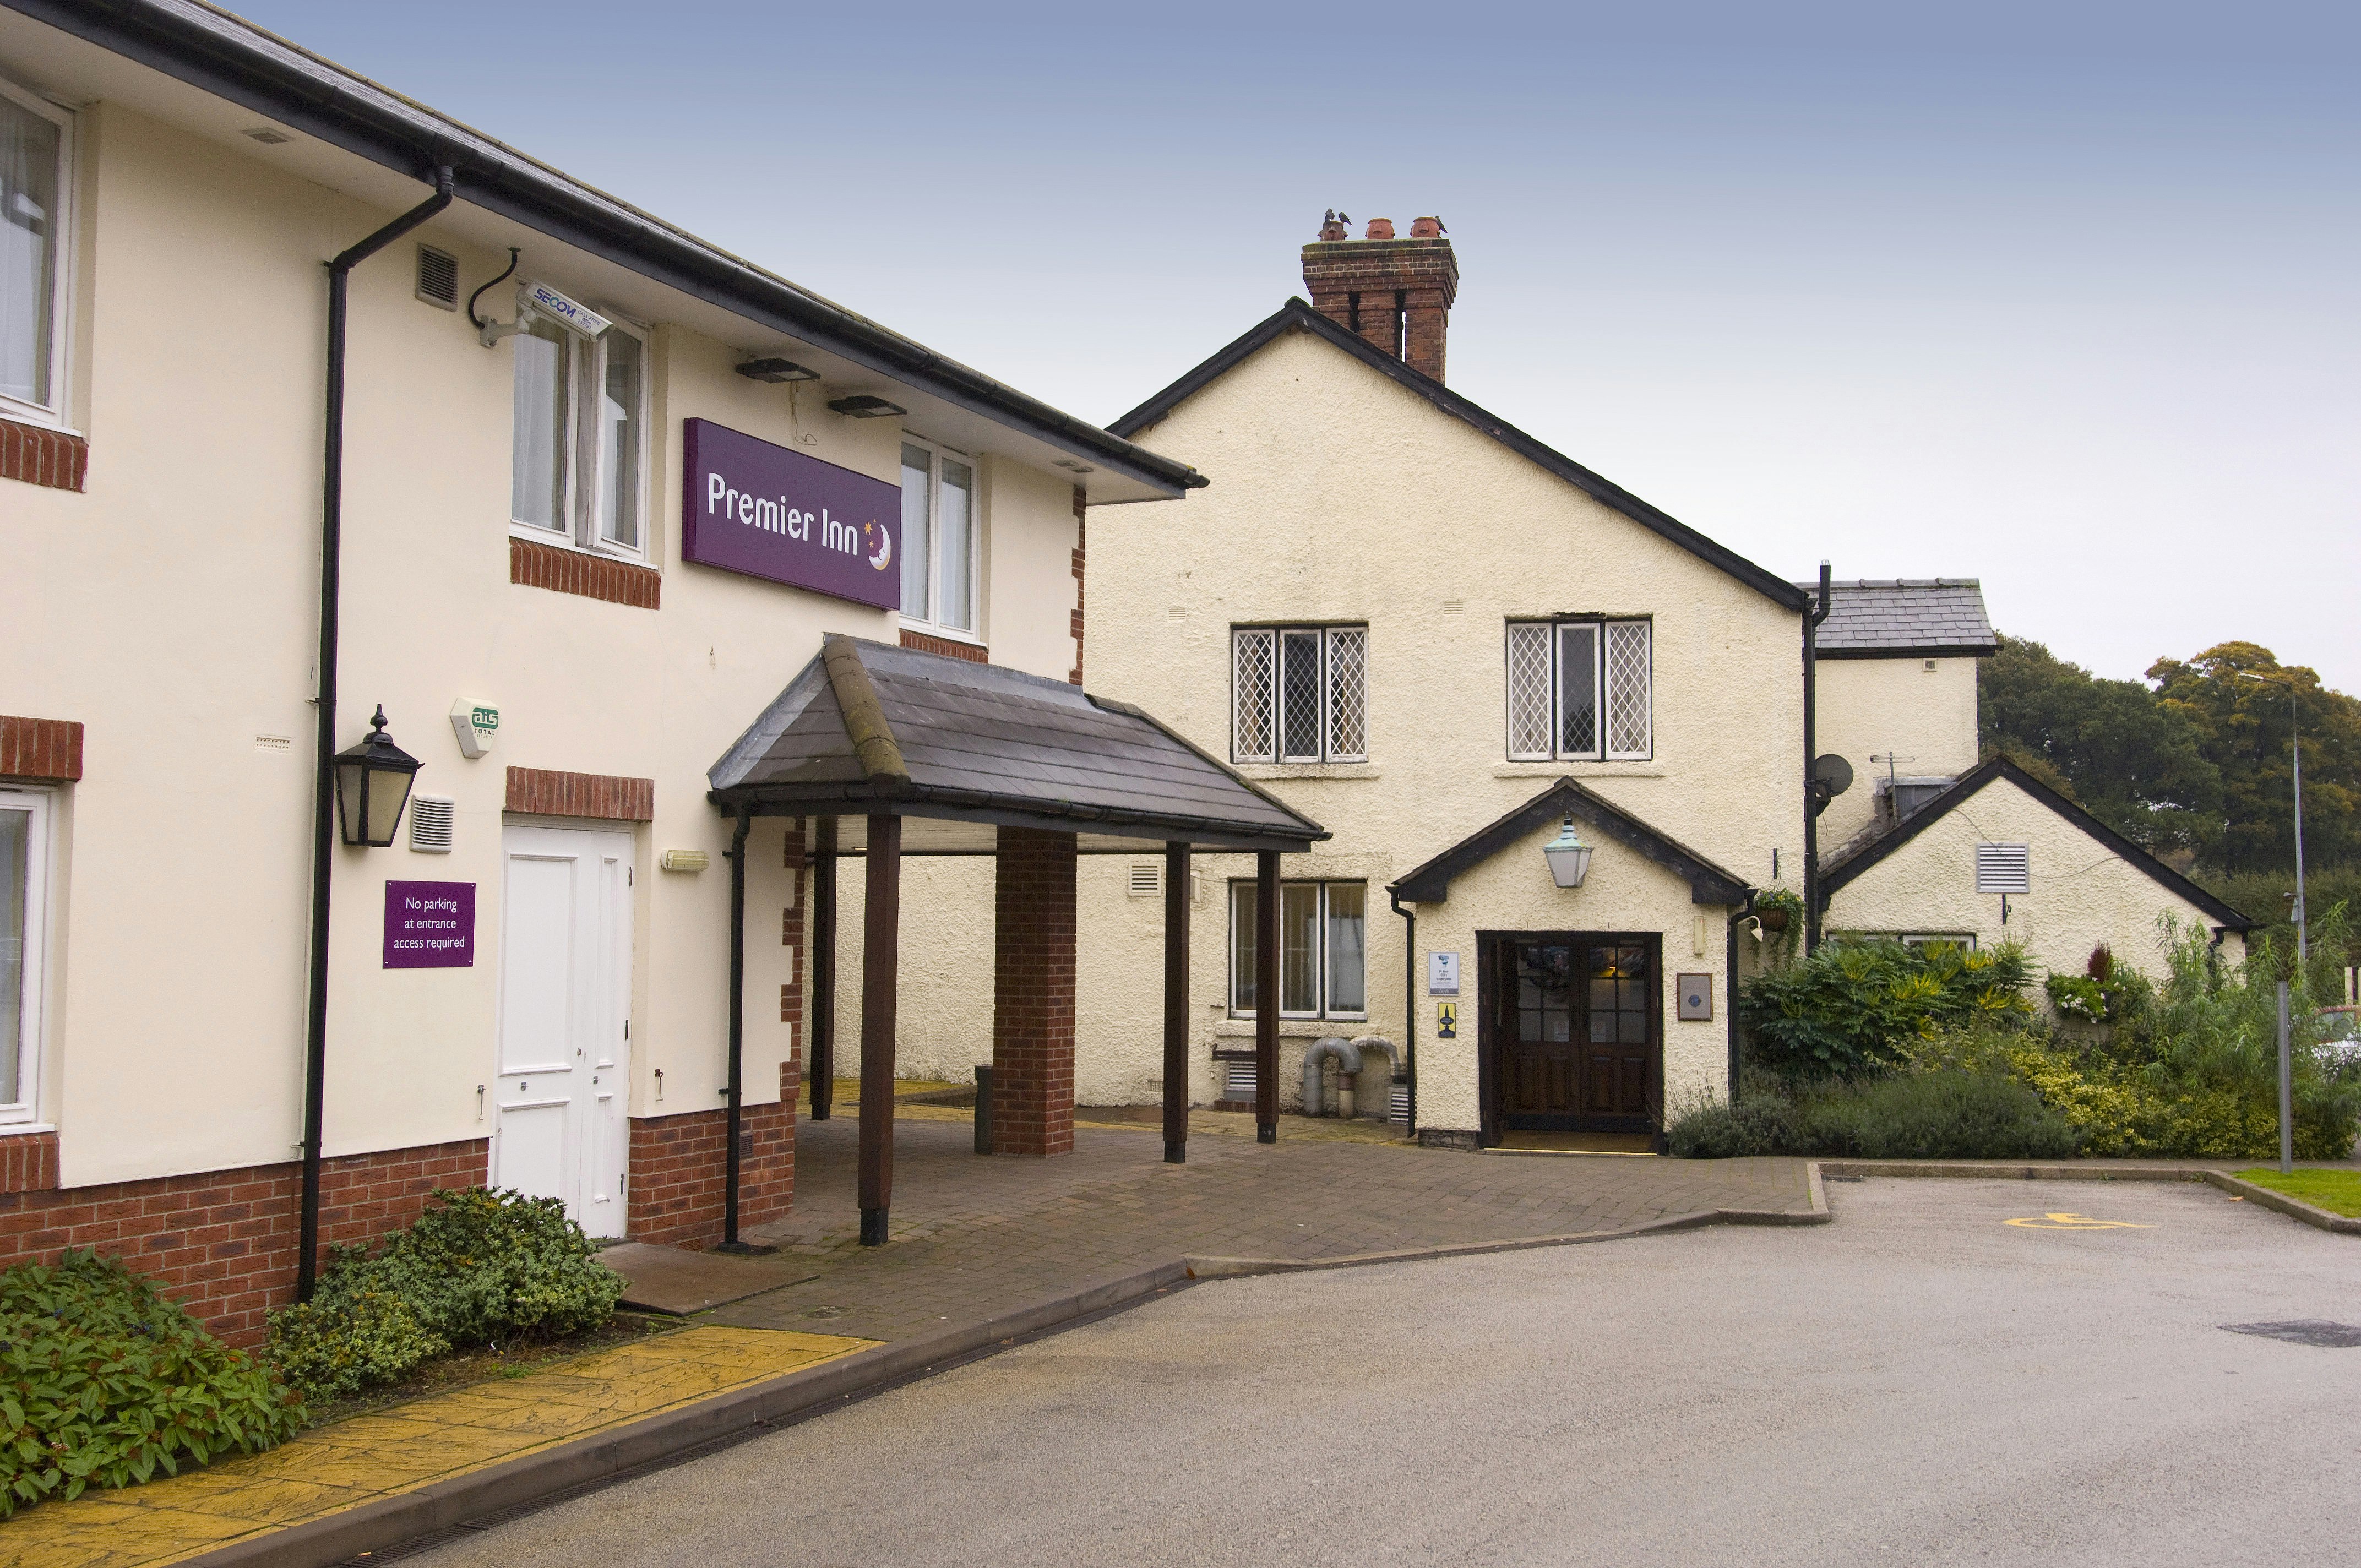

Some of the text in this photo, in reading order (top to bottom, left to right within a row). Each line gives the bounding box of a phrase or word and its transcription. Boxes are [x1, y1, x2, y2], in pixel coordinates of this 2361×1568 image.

[534, 288, 576, 318] SECOM
[578, 310, 600, 325] CALL FREE
[708, 472, 857, 556] Premier Inn
[472, 711, 498, 726] ais
[406, 897, 457, 913] No parking
[405, 919, 456, 929] at entrance
[394, 935, 465, 951] access required
